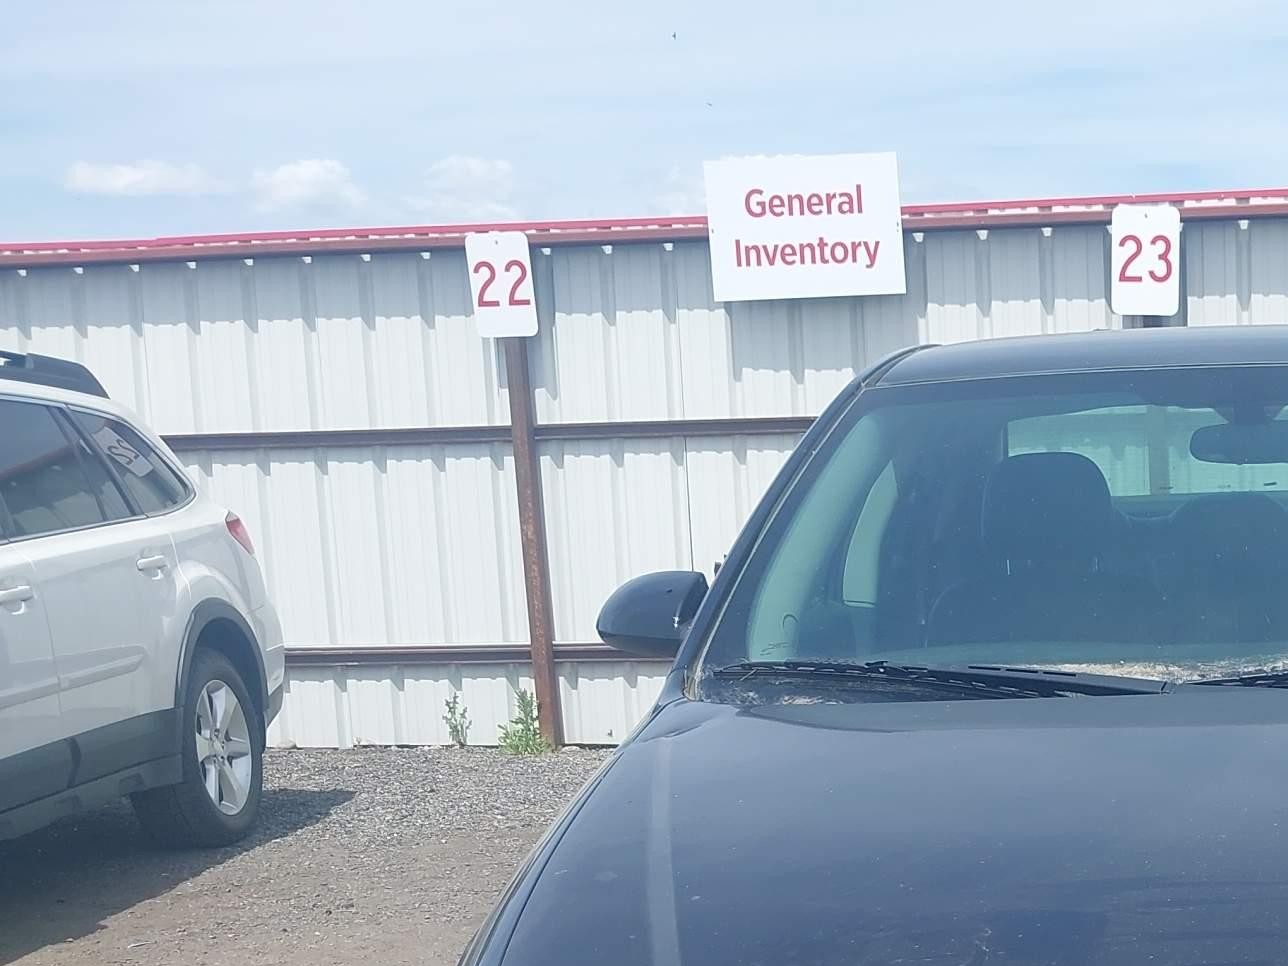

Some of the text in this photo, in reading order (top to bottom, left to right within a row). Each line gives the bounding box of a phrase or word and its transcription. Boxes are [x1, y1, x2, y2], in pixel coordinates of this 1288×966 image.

[745, 185, 863, 218] General
[736, 239, 879, 267] Inventory
[1119, 234, 1173, 283] 23
[474, 260, 529, 307] 22
